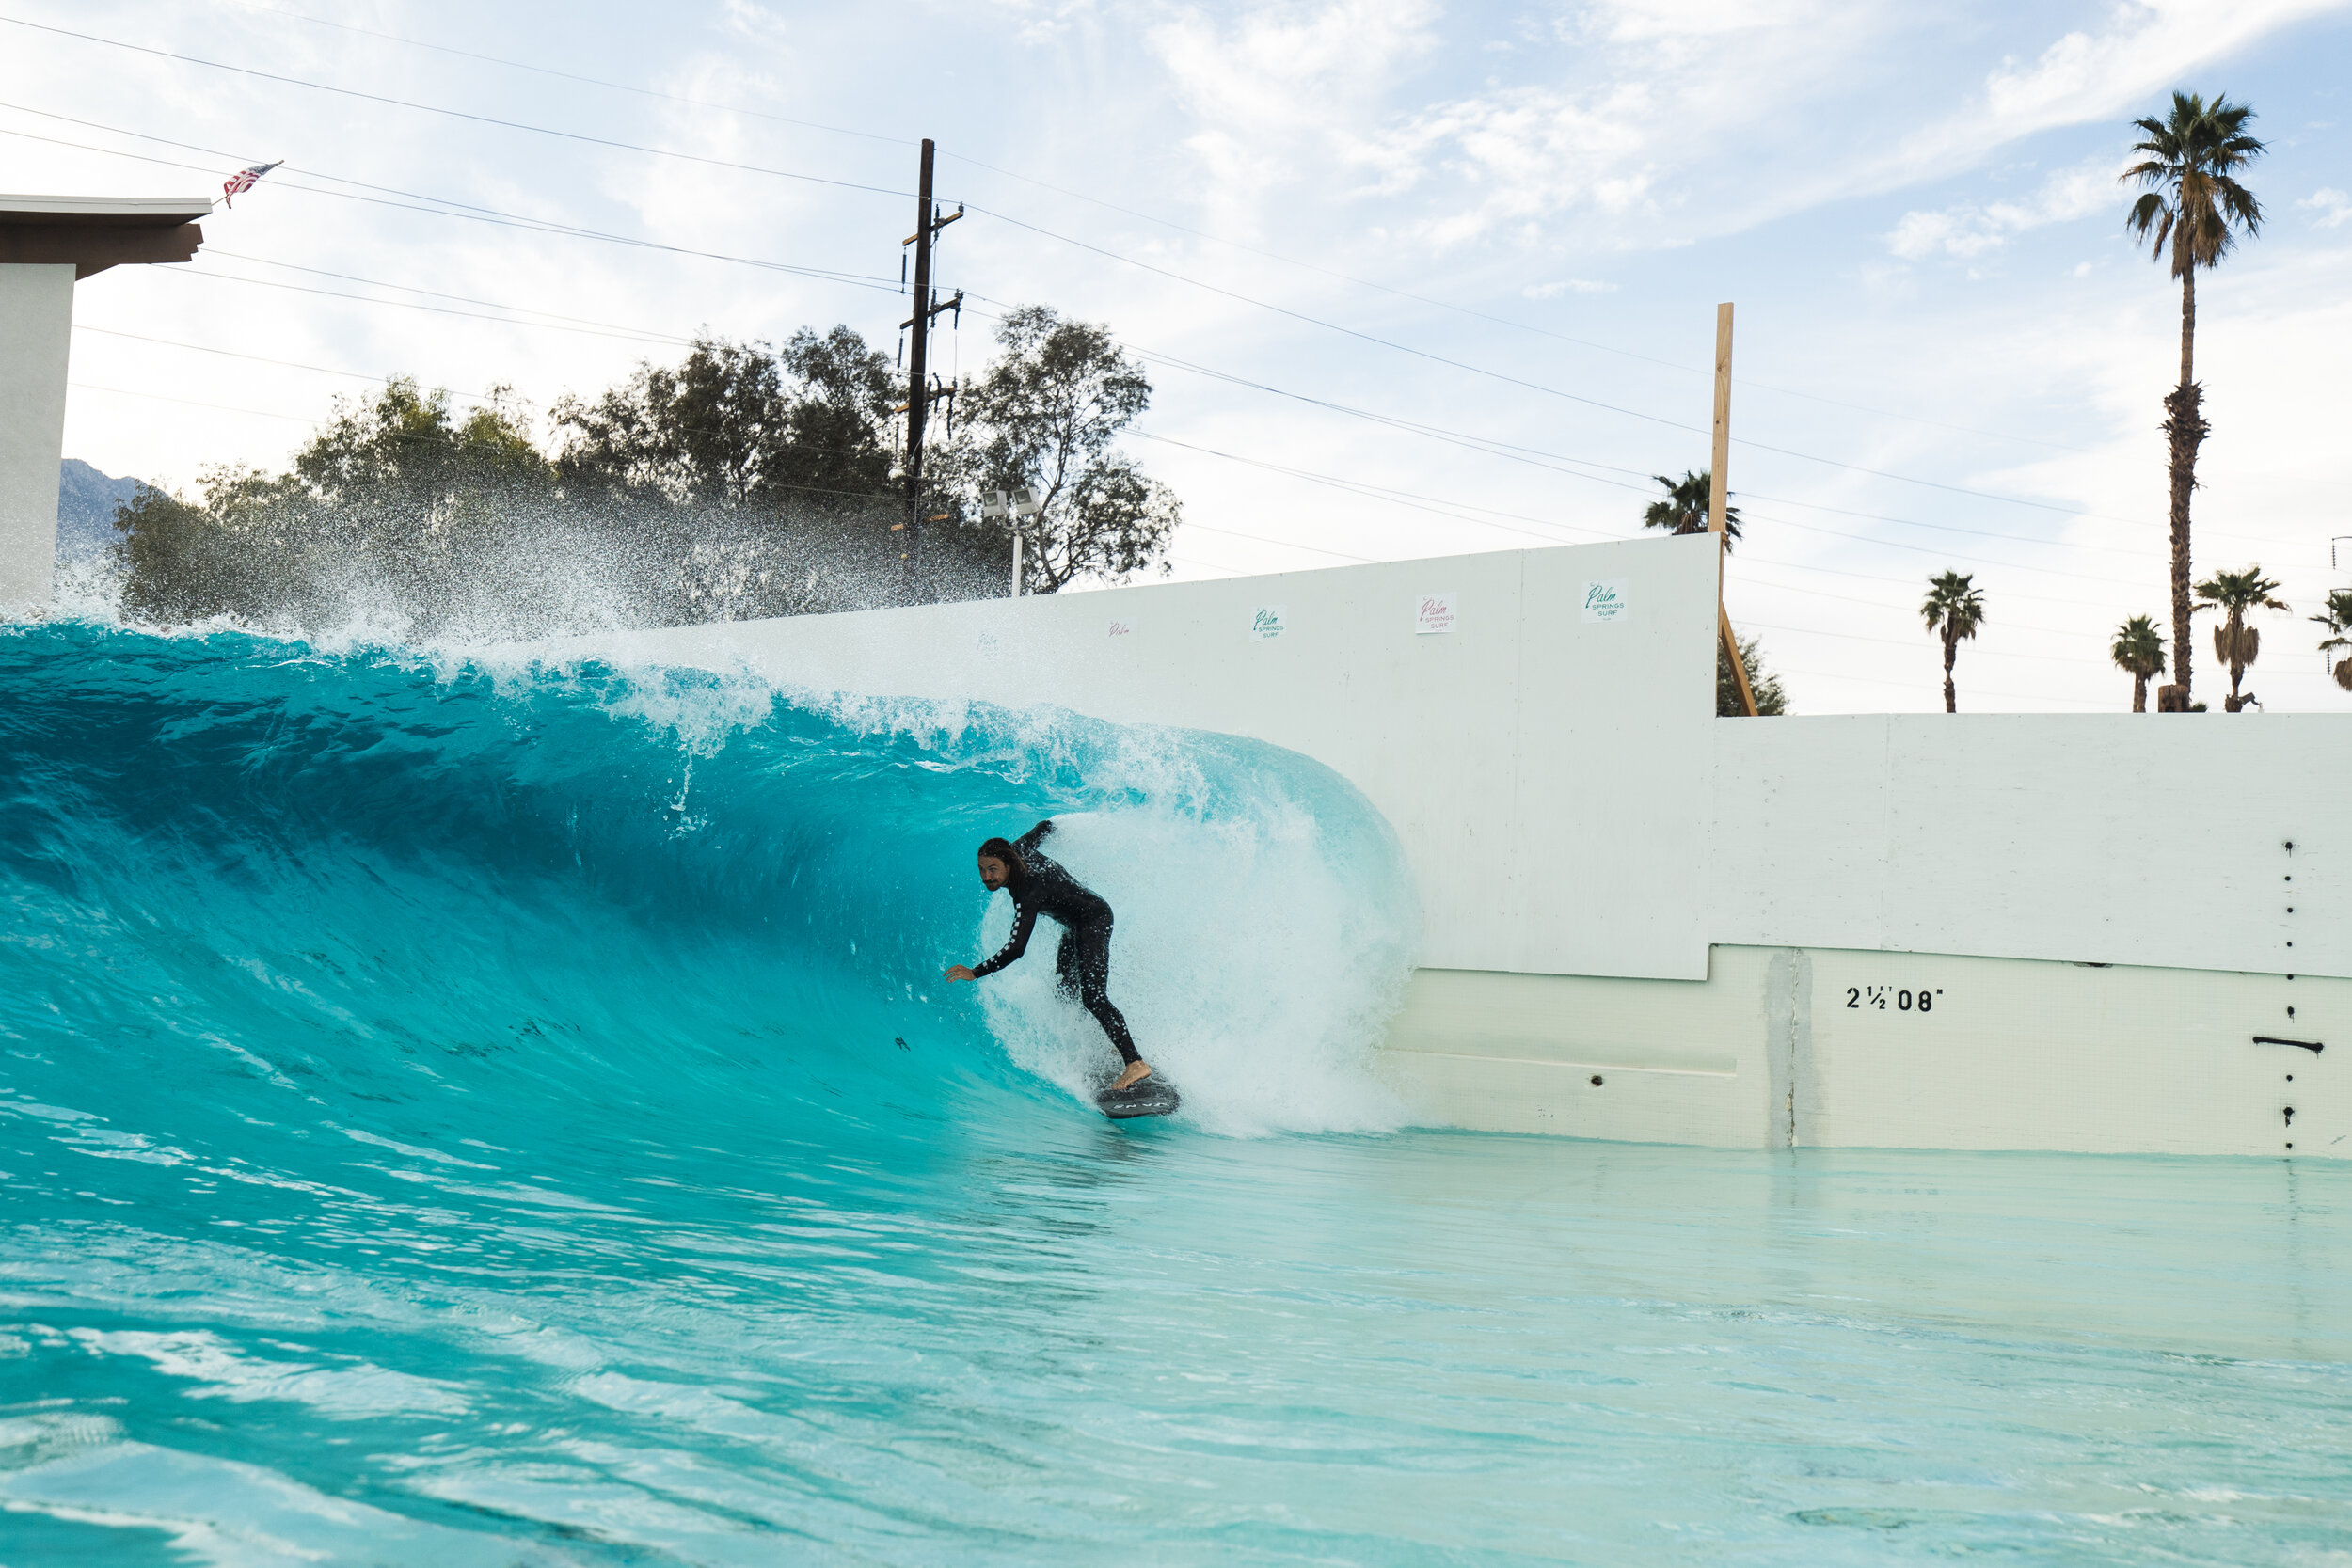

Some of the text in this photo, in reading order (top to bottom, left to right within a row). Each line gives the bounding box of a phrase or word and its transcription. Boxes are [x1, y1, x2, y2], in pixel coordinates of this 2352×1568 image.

[1585, 585, 1616, 609] Palm
[1253, 610, 1278, 630] Palm
[1420, 599, 1447, 622] Palm
[1847, 988, 1860, 1008] 2
